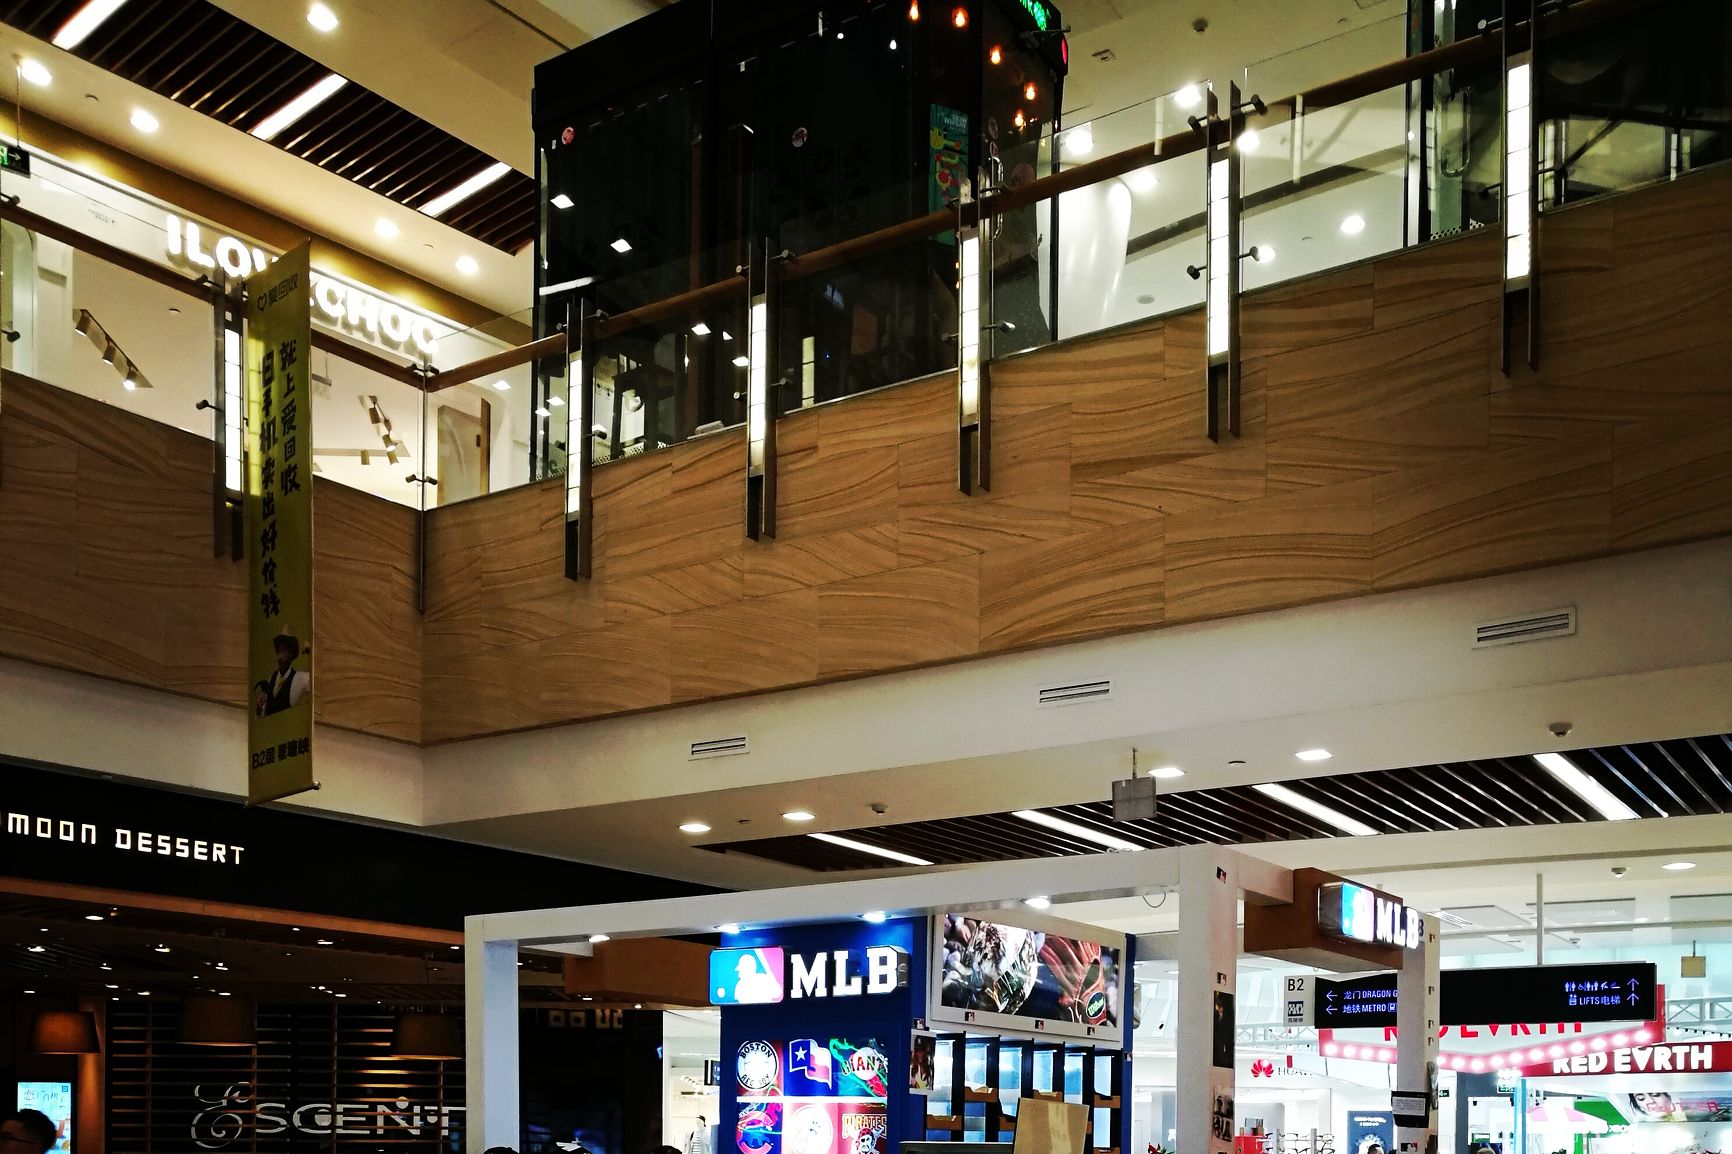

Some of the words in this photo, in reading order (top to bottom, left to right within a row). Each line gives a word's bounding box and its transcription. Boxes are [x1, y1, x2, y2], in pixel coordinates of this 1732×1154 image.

[279, 339, 301, 496] 就上爱回收
[114, 828, 245, 864] DESSERT
[1376, 897, 1420, 950] MLB
[790, 946, 899, 998] MLB
[1287, 978, 1305, 992] B2
[1362, 989, 1392, 999] DRAGON
[1343, 1004, 1362, 1014] 地铁
[1361, 1003, 1387, 1013] METRO
[1579, 996, 1600, 1006] LIFTS
[1600, 996, 1621, 1006] 电梯
[740, 1041, 772, 1059] BOSTON
[1552, 1051, 1608, 1074] RED
[842, 1113, 888, 1139] PIRATES
